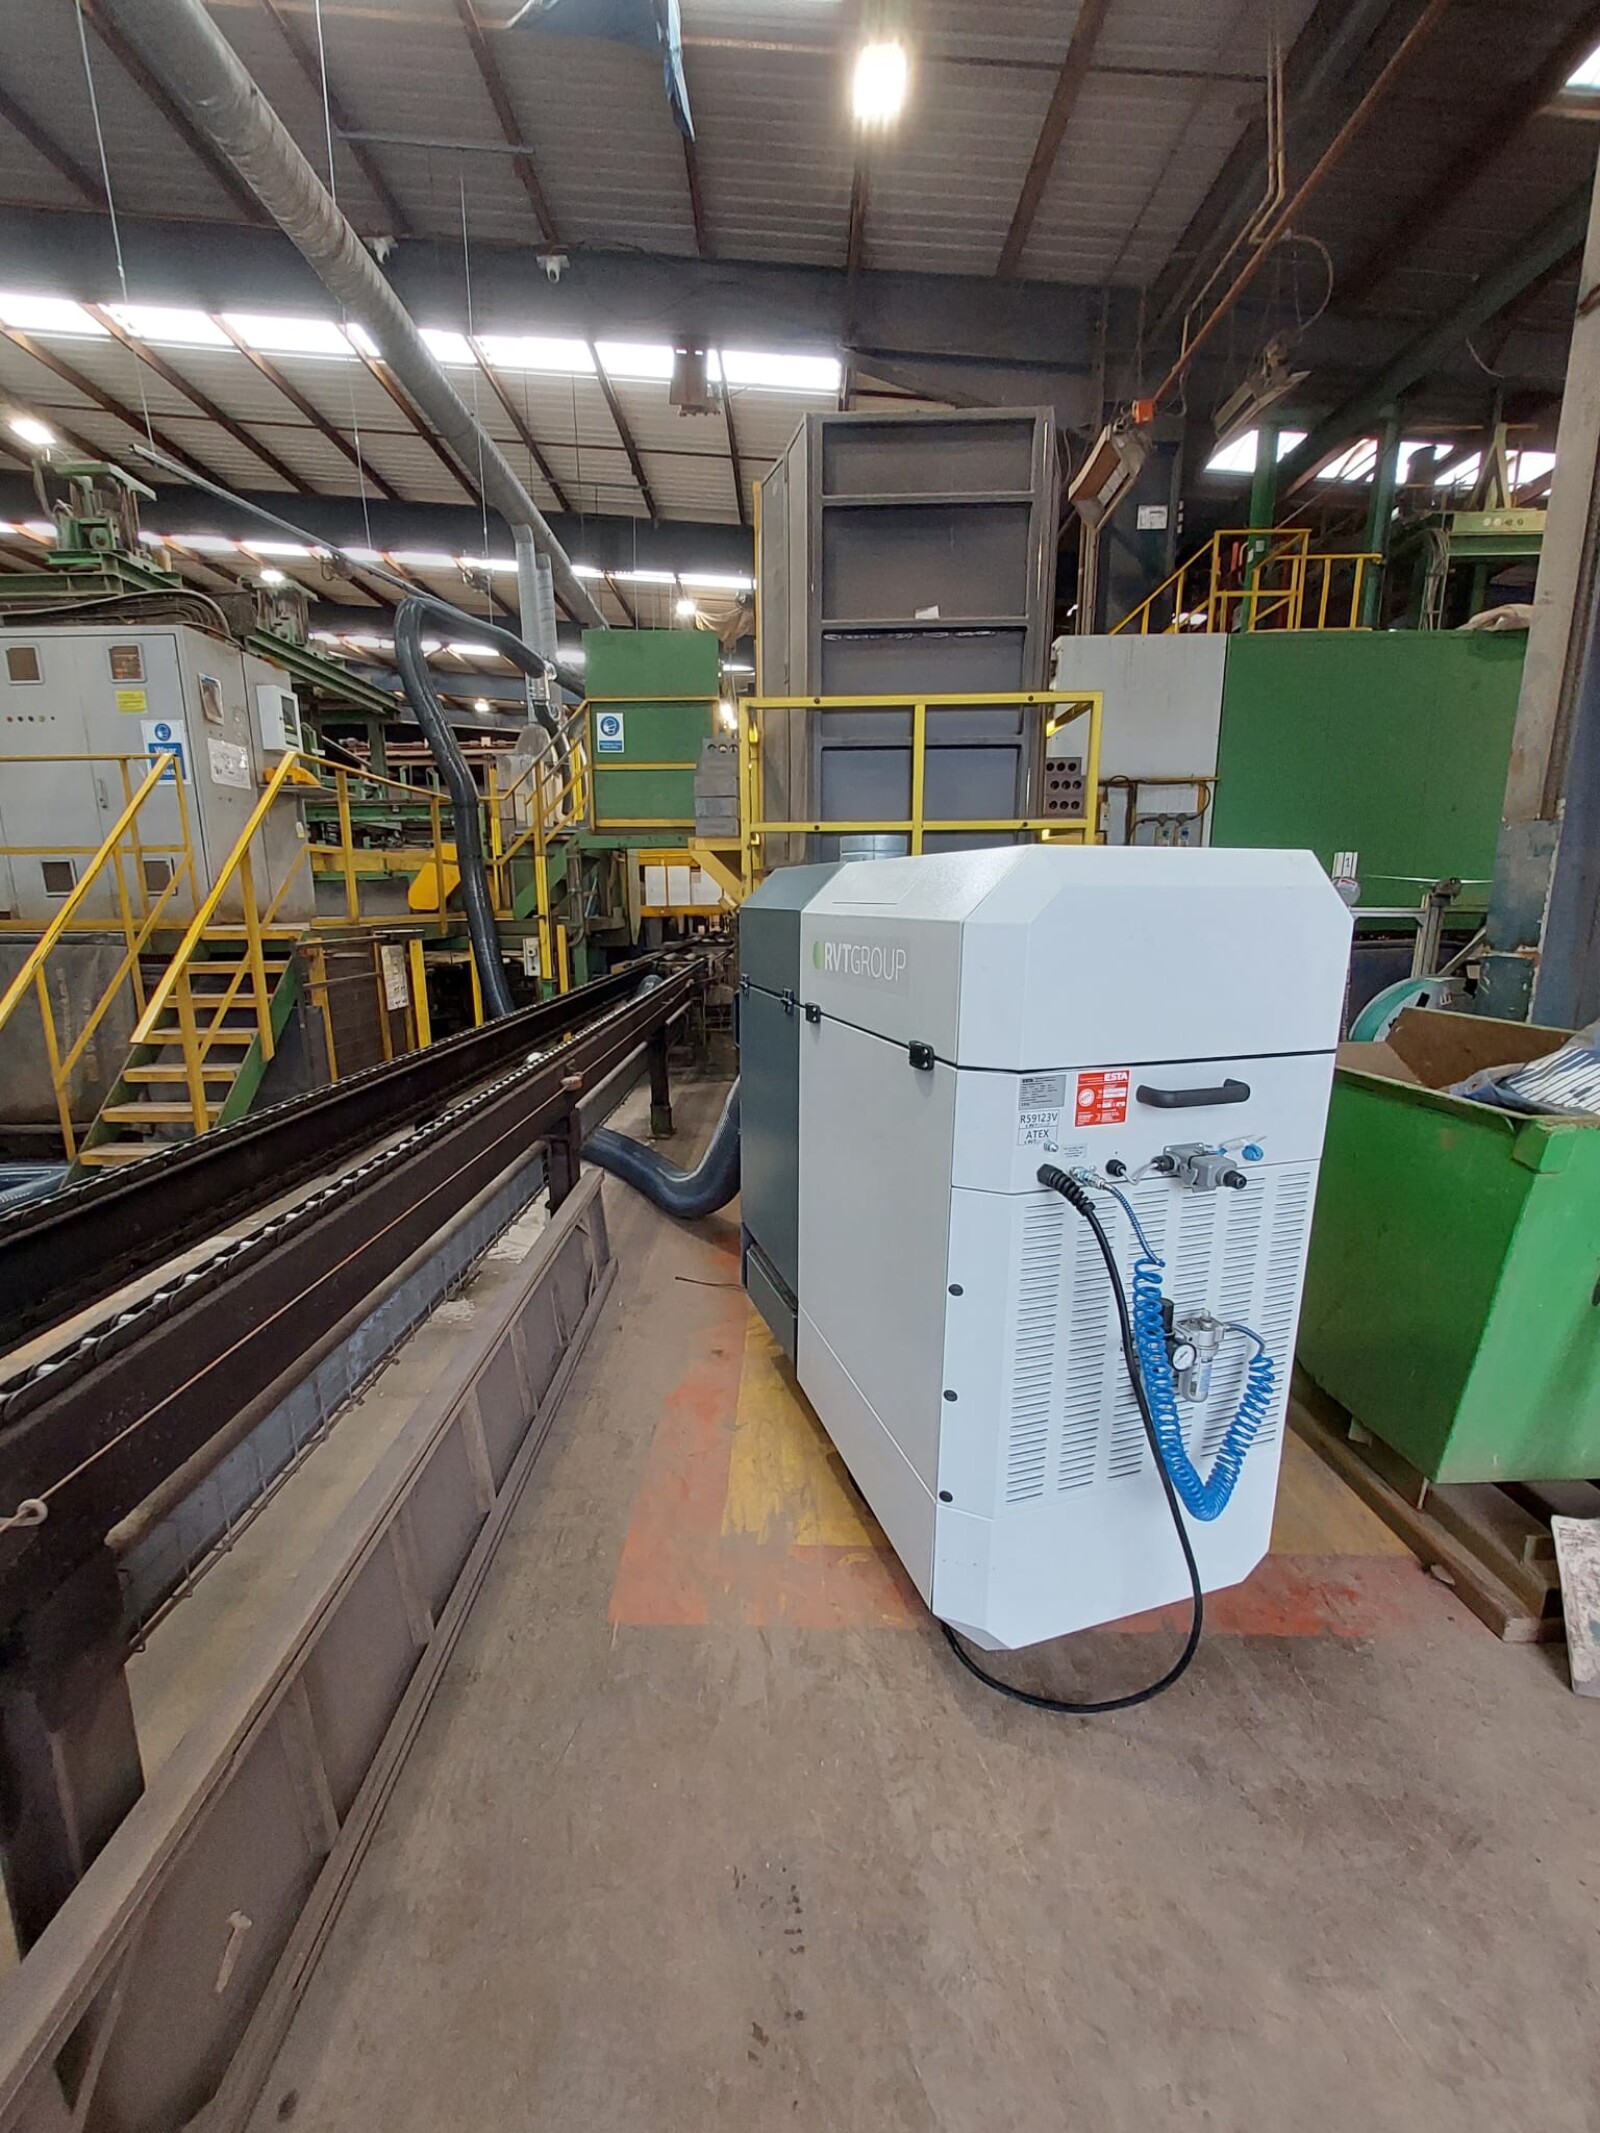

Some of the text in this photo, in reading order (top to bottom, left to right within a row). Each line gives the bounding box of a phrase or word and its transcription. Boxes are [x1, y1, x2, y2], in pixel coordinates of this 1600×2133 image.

[824, 942, 906, 981] RVTGROUP
[1104, 1072, 1128, 1082] ESTA
[1020, 1112, 1058, 1124] R59123V
[1026, 1129, 1049, 1140] ATEX
